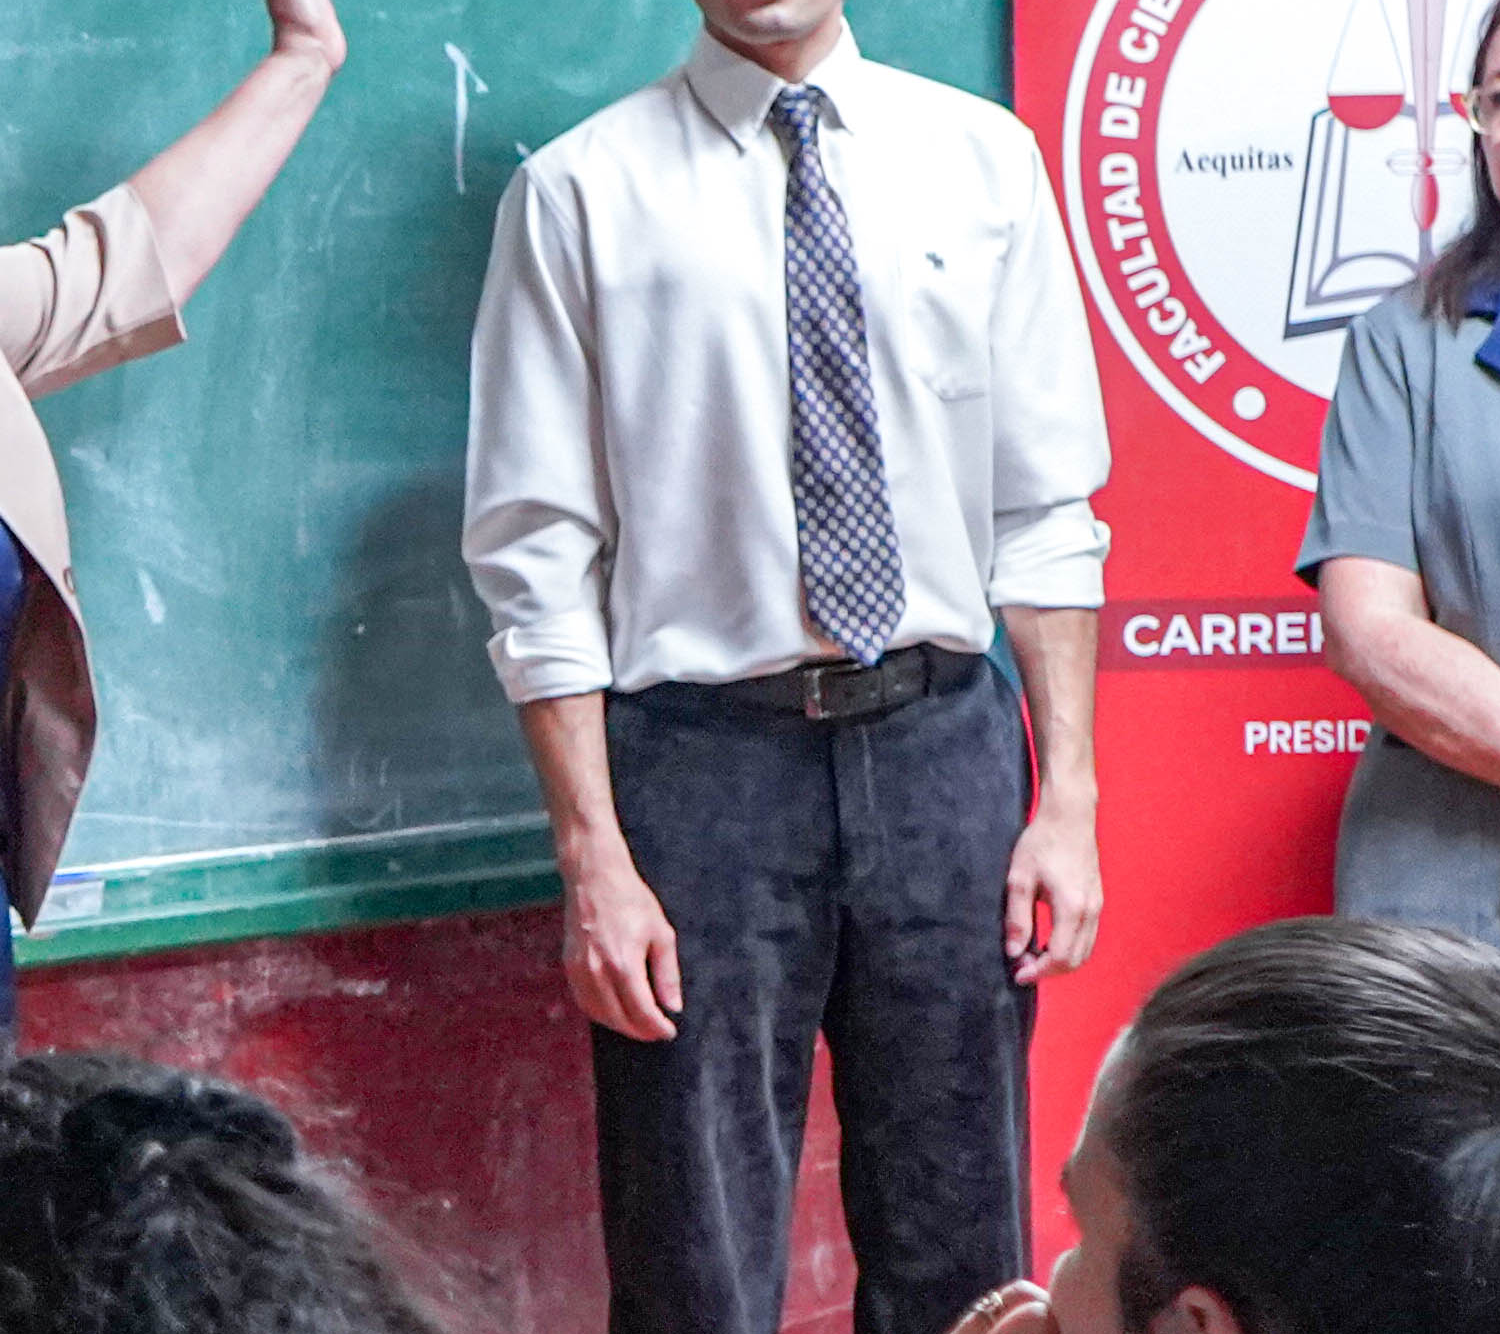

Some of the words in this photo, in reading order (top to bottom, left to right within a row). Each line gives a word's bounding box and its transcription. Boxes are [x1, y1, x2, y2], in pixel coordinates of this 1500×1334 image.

[1099, 71, 1149, 141] DE
[1174, 145, 1295, 179] Aequitas
[1099, 151, 1226, 385] FACULTAD
